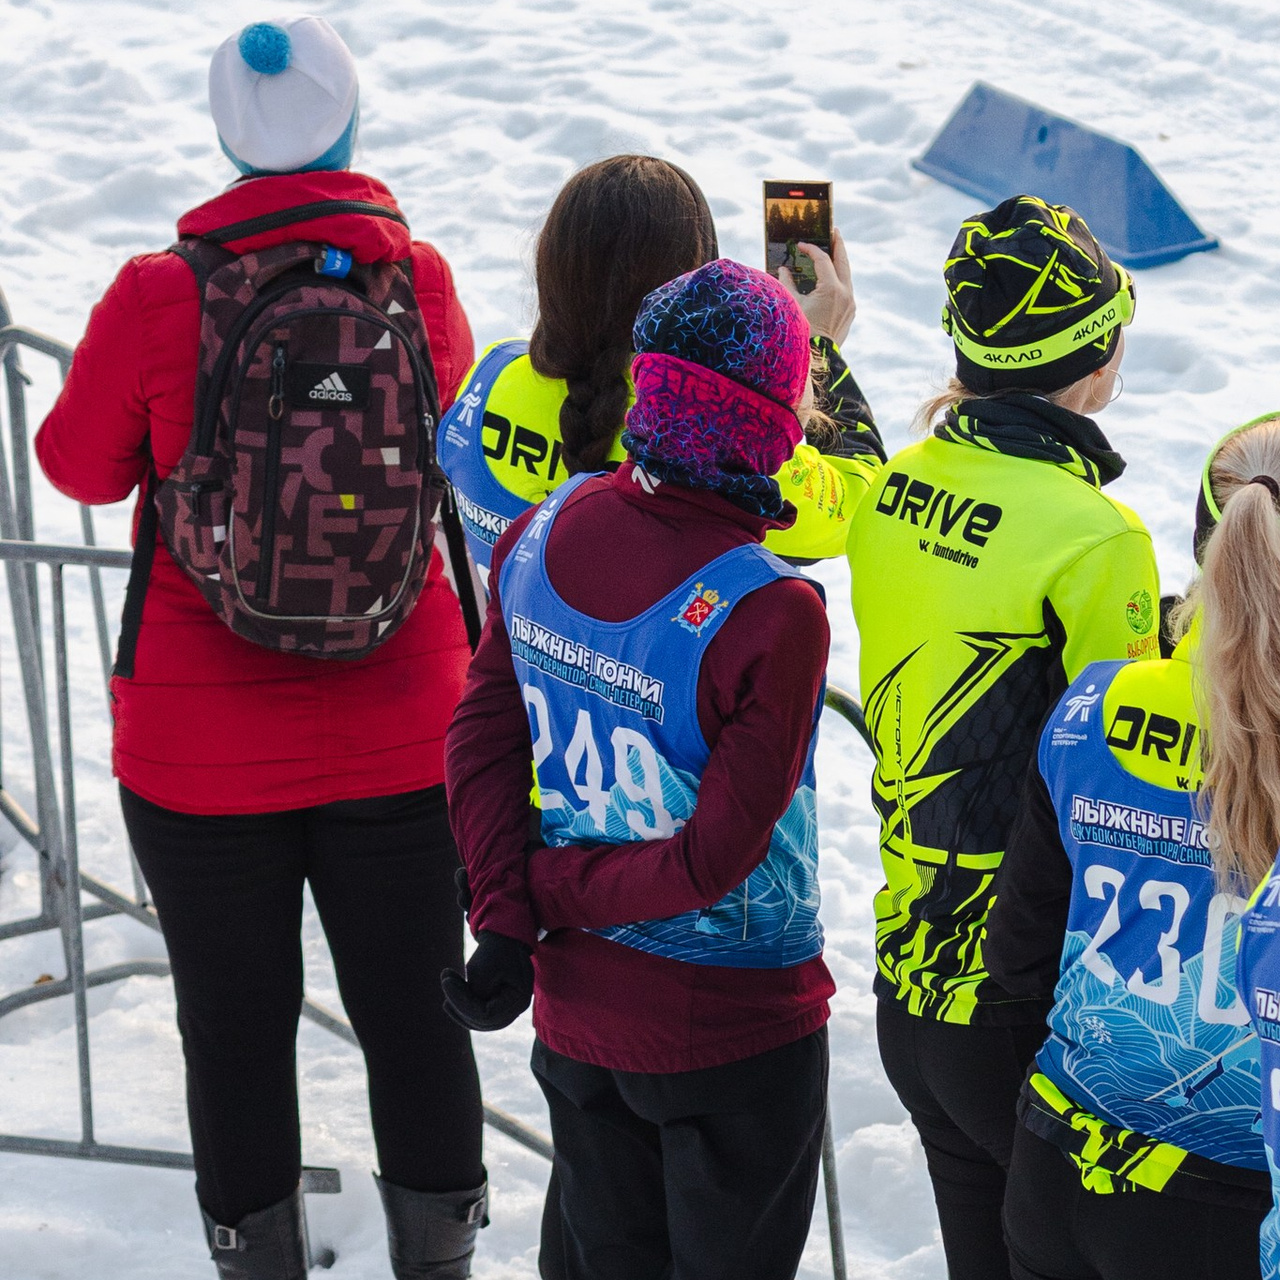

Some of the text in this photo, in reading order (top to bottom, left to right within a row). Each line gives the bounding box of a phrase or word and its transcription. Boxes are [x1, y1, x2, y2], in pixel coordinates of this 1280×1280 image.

[308, 389, 353, 402] adidas
[481, 410, 564, 481] DRI
[931, 541, 979, 570] funtodrive
[511, 614, 663, 705] ЛЫЖНЫЕ ГОНКИ
[893, 682, 903, 770] VICTORY
[1105, 704, 1211, 773] DRI
[523, 682, 676, 841] 249
[1074, 797, 1184, 842] ЛЫЖНЫЕ
[1079, 824, 1111, 845] КУБОК
[1112, 830, 1179, 861] ГУБЕРНАТОРА
